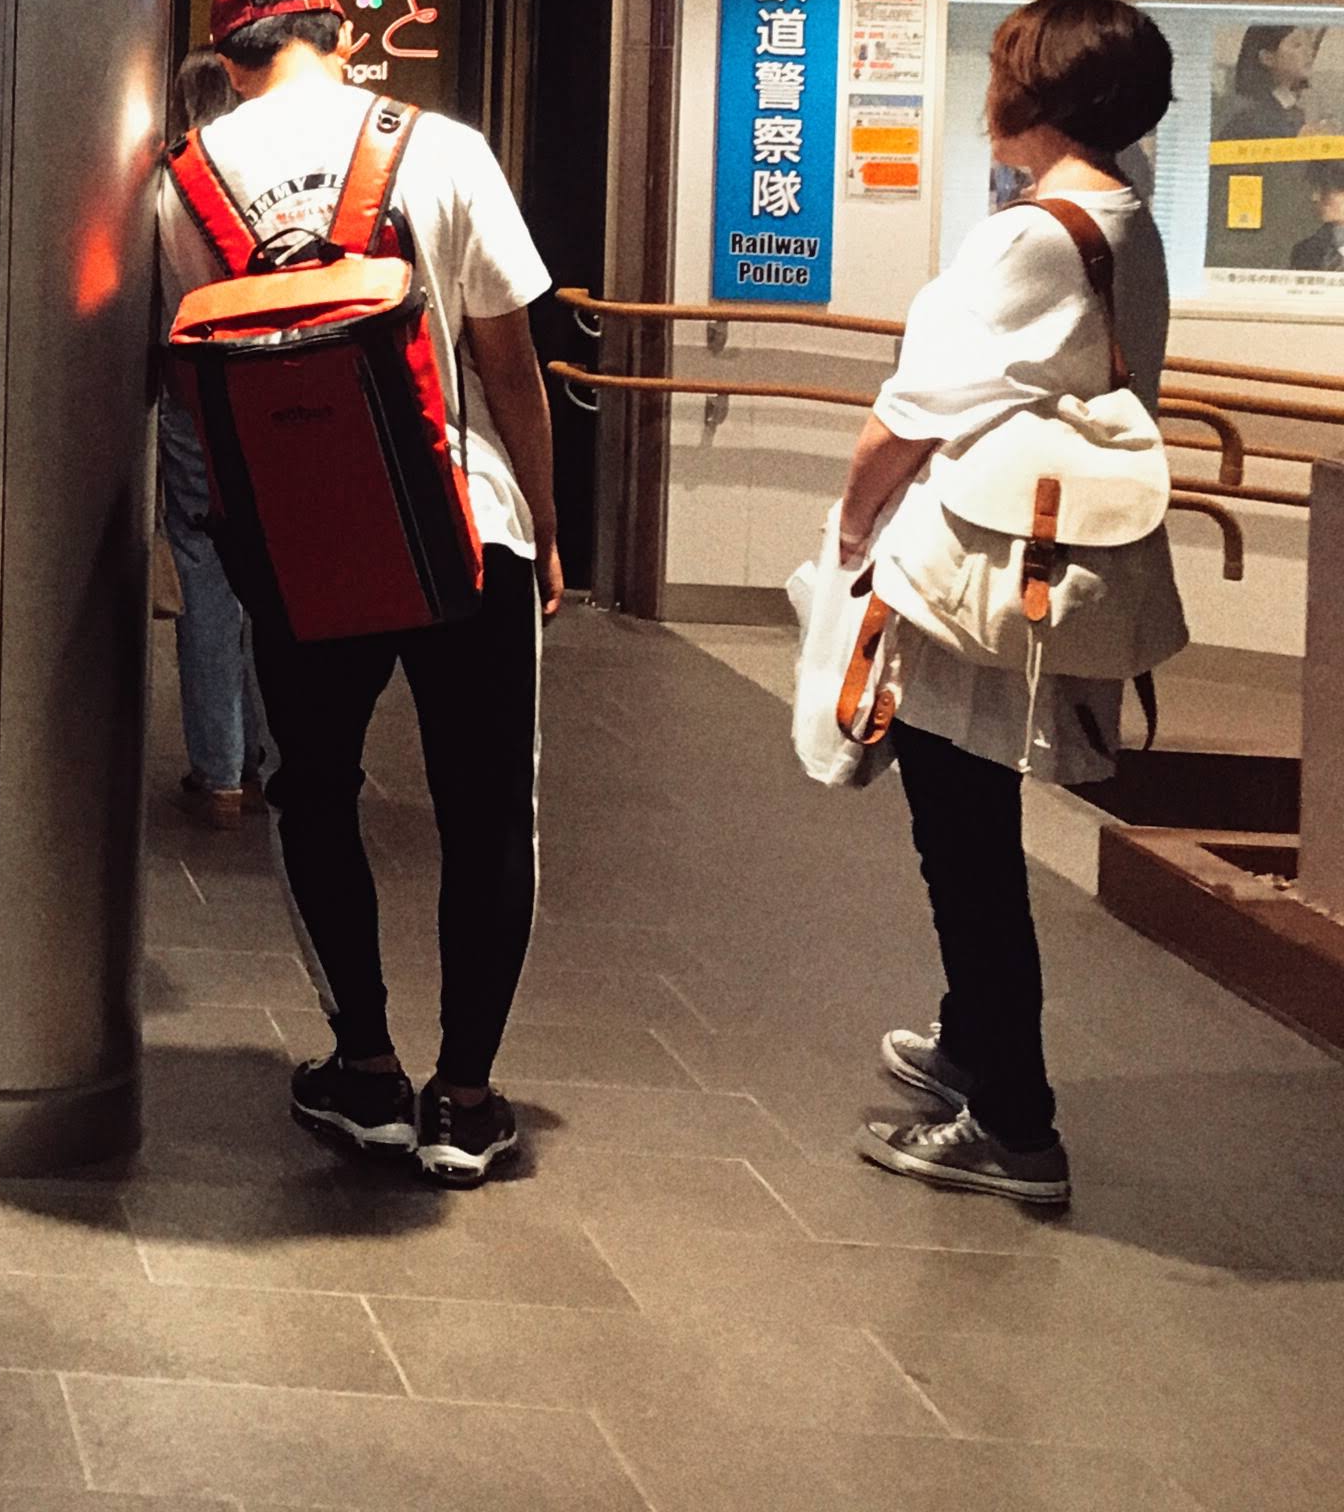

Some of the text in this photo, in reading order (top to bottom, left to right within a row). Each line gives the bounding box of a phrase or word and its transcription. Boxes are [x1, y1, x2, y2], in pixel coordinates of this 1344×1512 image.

[245, 175, 308, 227] OMMY
[730, 233, 819, 260] Railway
[738, 261, 810, 284] Police
